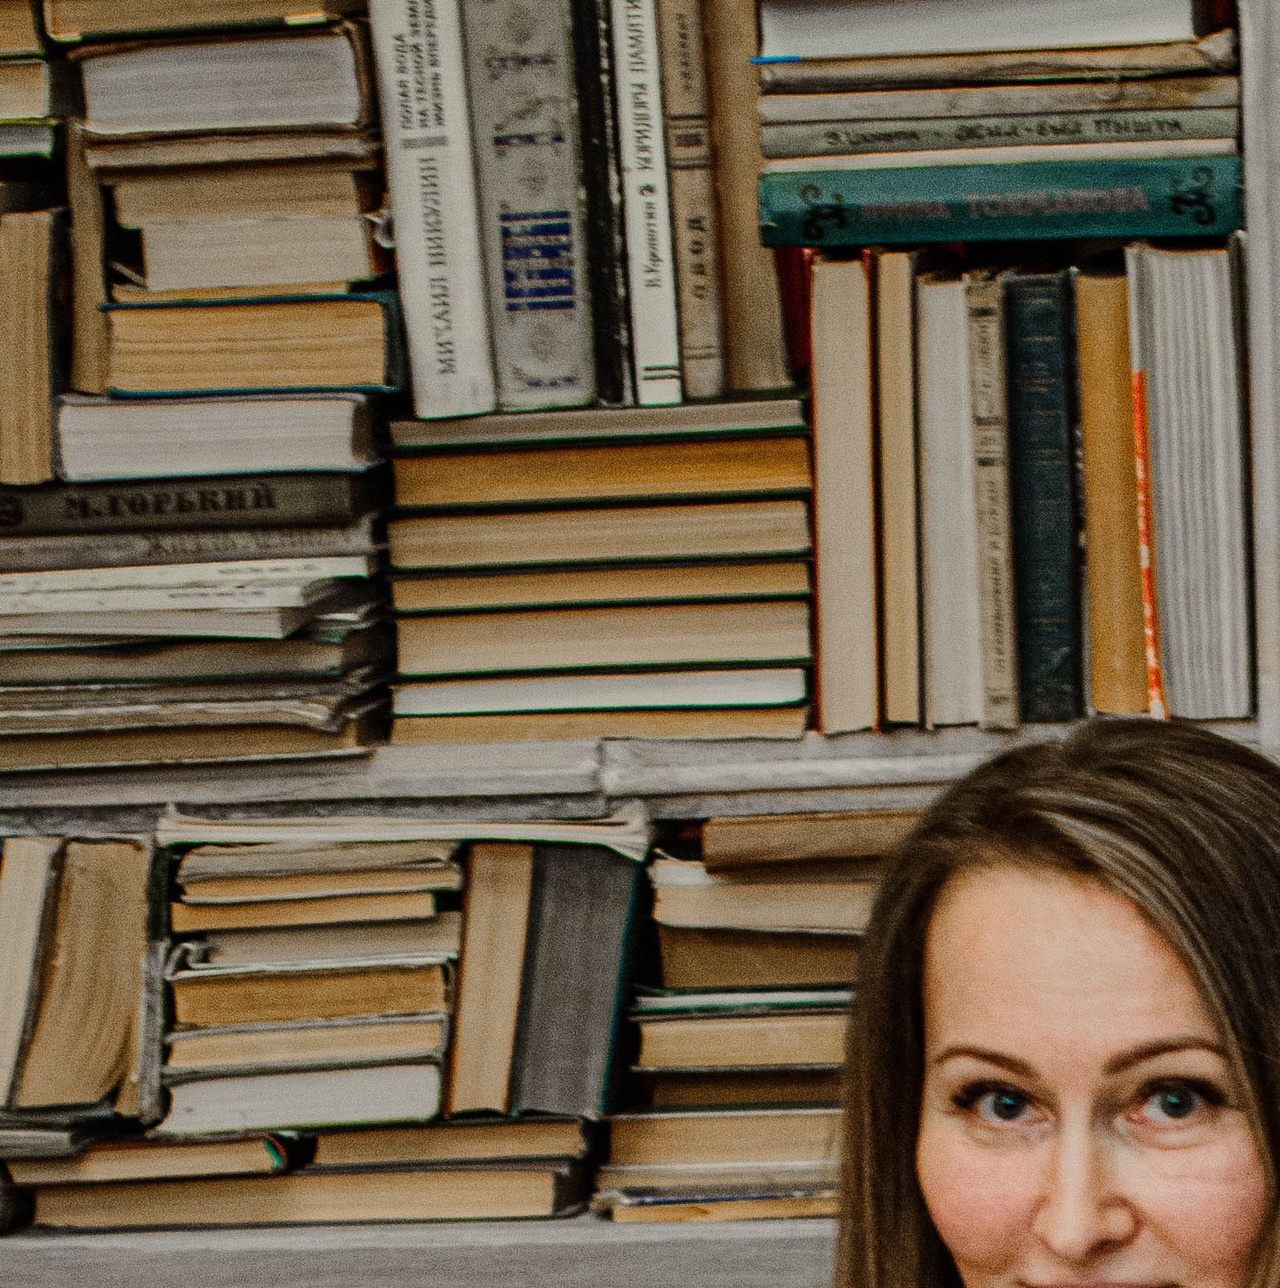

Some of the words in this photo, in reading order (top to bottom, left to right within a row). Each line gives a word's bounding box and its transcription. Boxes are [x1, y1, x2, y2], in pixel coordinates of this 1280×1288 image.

[630, 82, 656, 172] КОРИДОРЫ
[416, 156, 447, 267] НИКУЛИН
[427, 276, 458, 377] МИХАИЛ
